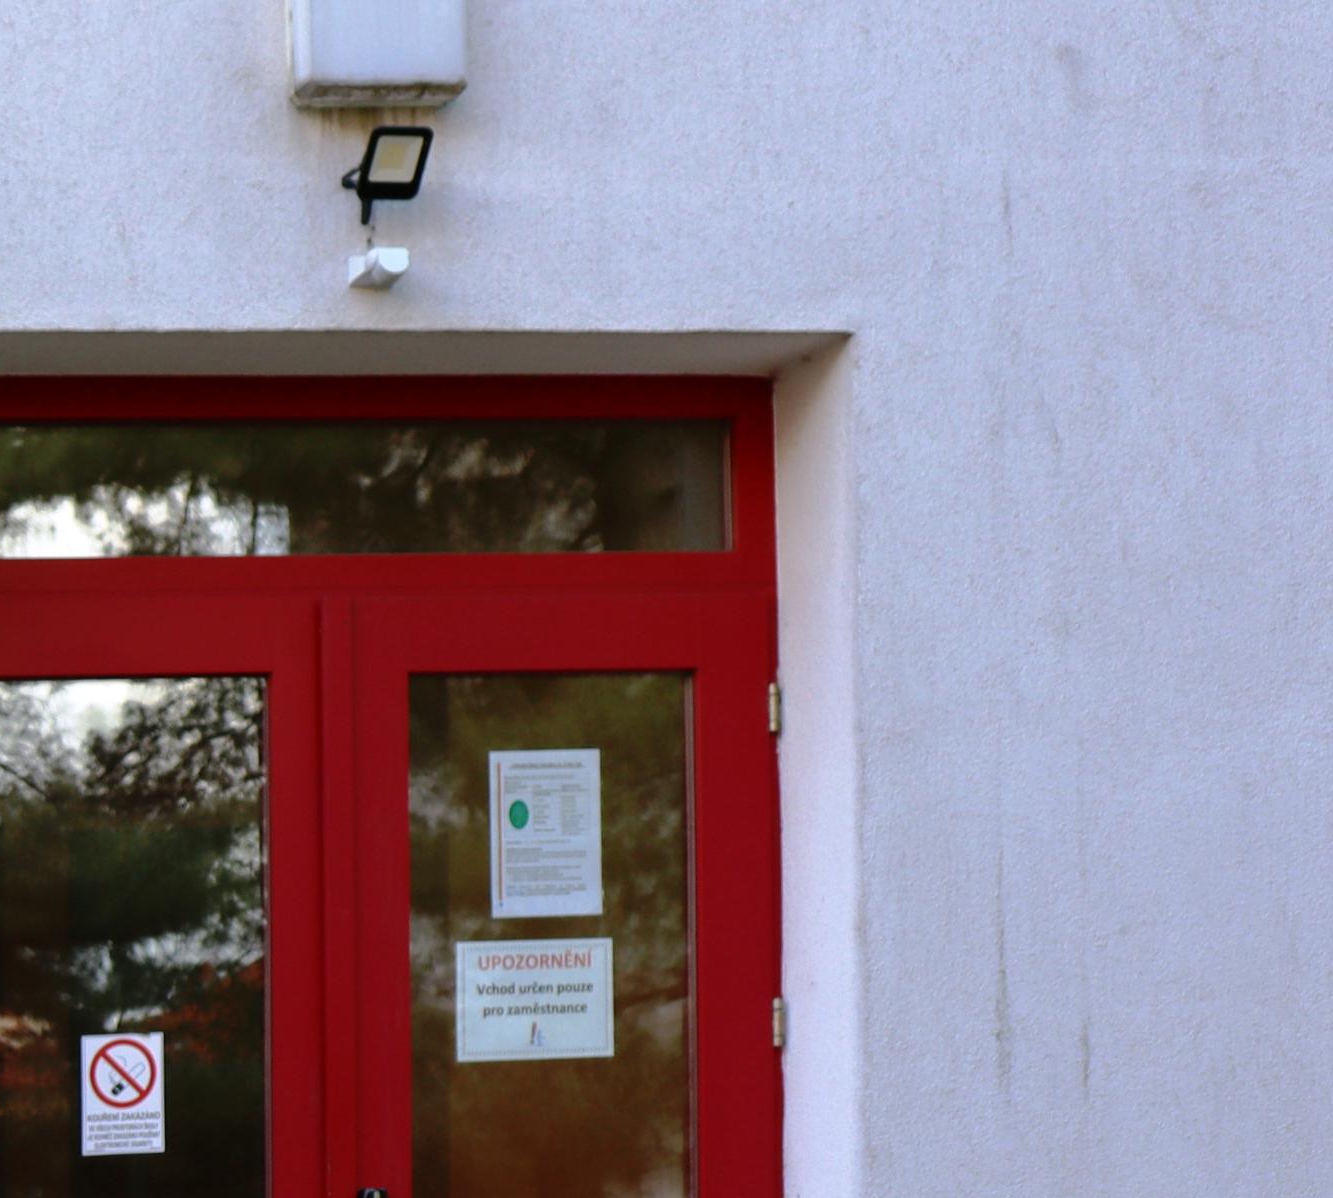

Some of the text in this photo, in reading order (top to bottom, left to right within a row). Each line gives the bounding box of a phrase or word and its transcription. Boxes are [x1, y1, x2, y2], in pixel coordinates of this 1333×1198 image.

[478, 949, 592, 971] UPOZORNĚNÍ
[477, 981, 594, 996] Vchod určen pouze
[483, 1002, 588, 1019] pro zaměstnance
